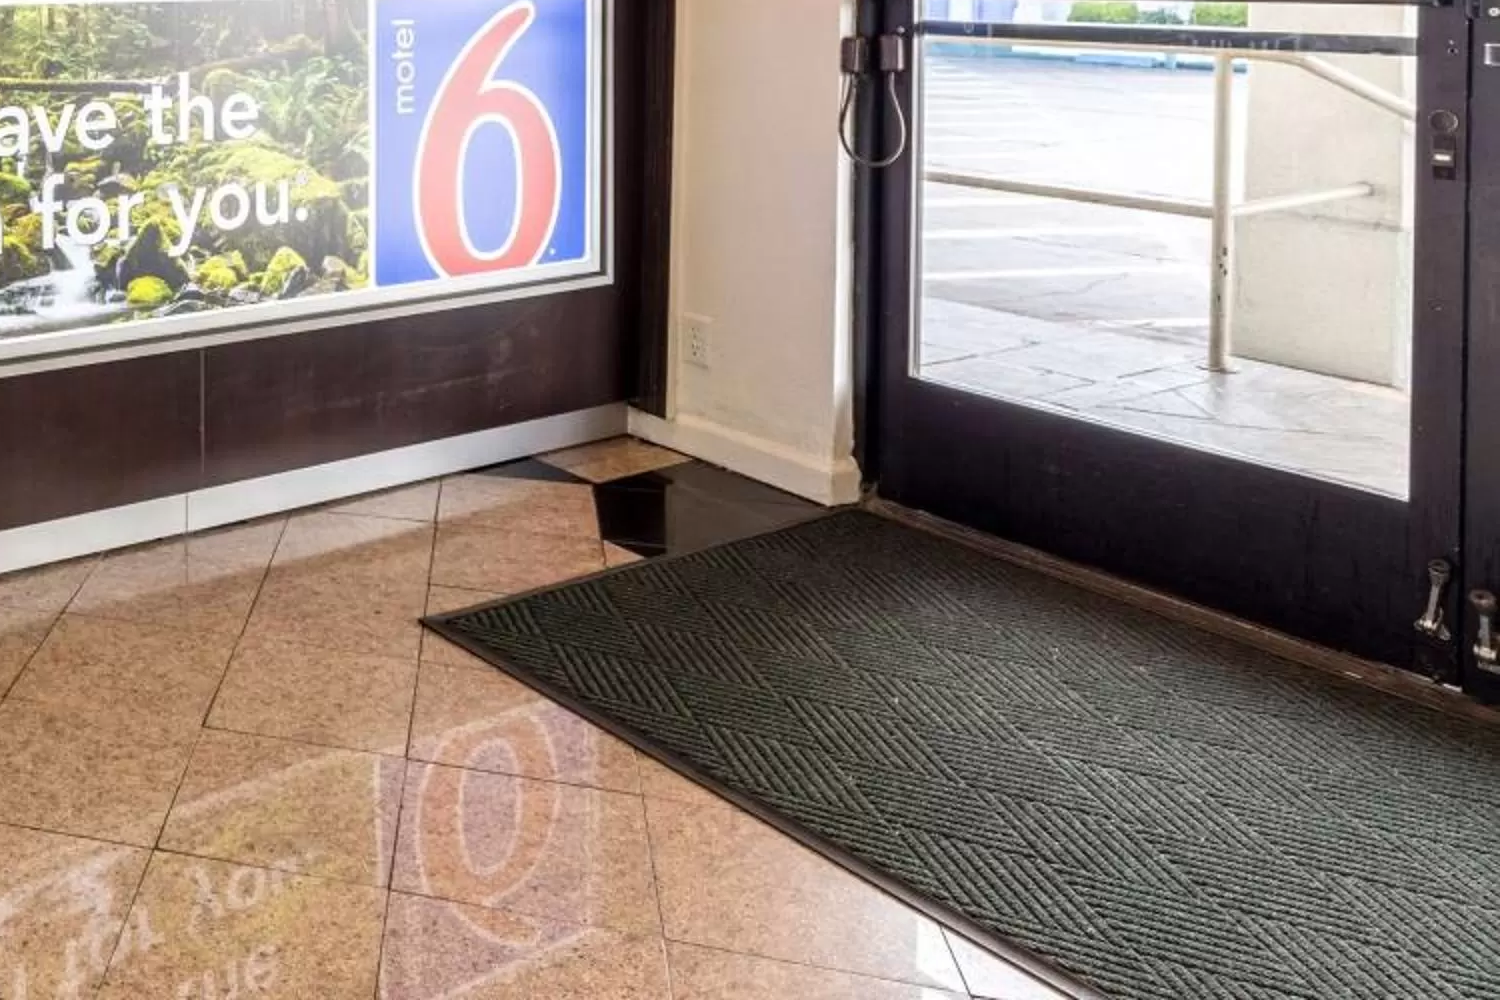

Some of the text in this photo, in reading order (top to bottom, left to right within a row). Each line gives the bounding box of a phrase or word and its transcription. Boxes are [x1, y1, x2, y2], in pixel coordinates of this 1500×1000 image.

[143, 72, 259, 145] the
[391, 0, 562, 278] motel 6
[30, 173, 145, 249] for
